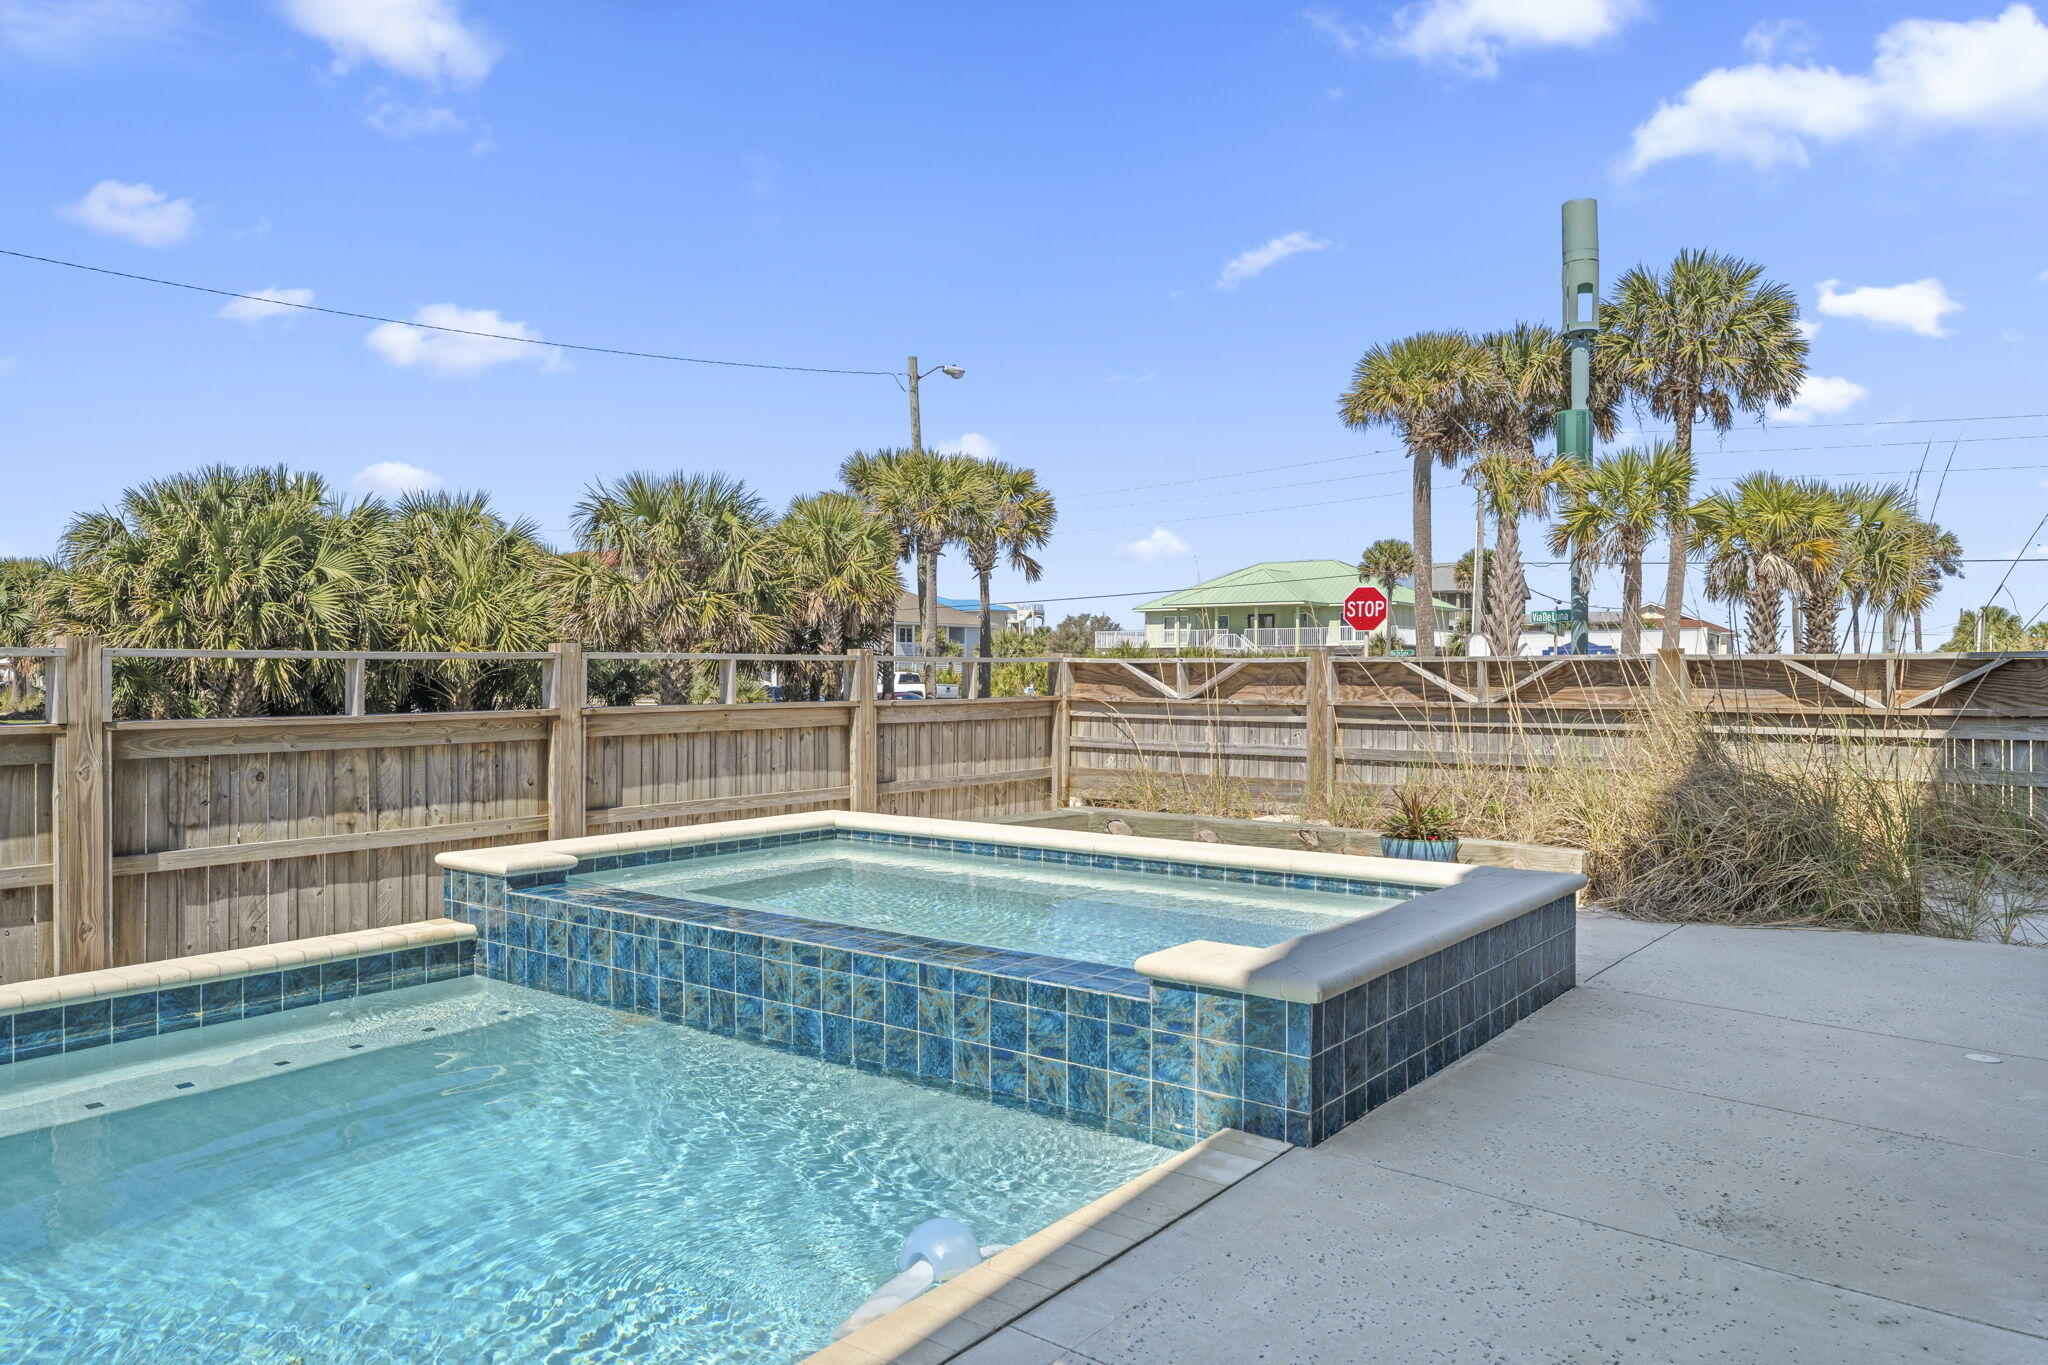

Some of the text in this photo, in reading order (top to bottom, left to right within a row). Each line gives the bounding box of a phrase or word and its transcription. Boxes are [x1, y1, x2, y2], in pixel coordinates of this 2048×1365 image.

[1346, 600, 1385, 618] STOP
[1532, 611, 1569, 622] Via De Luna
